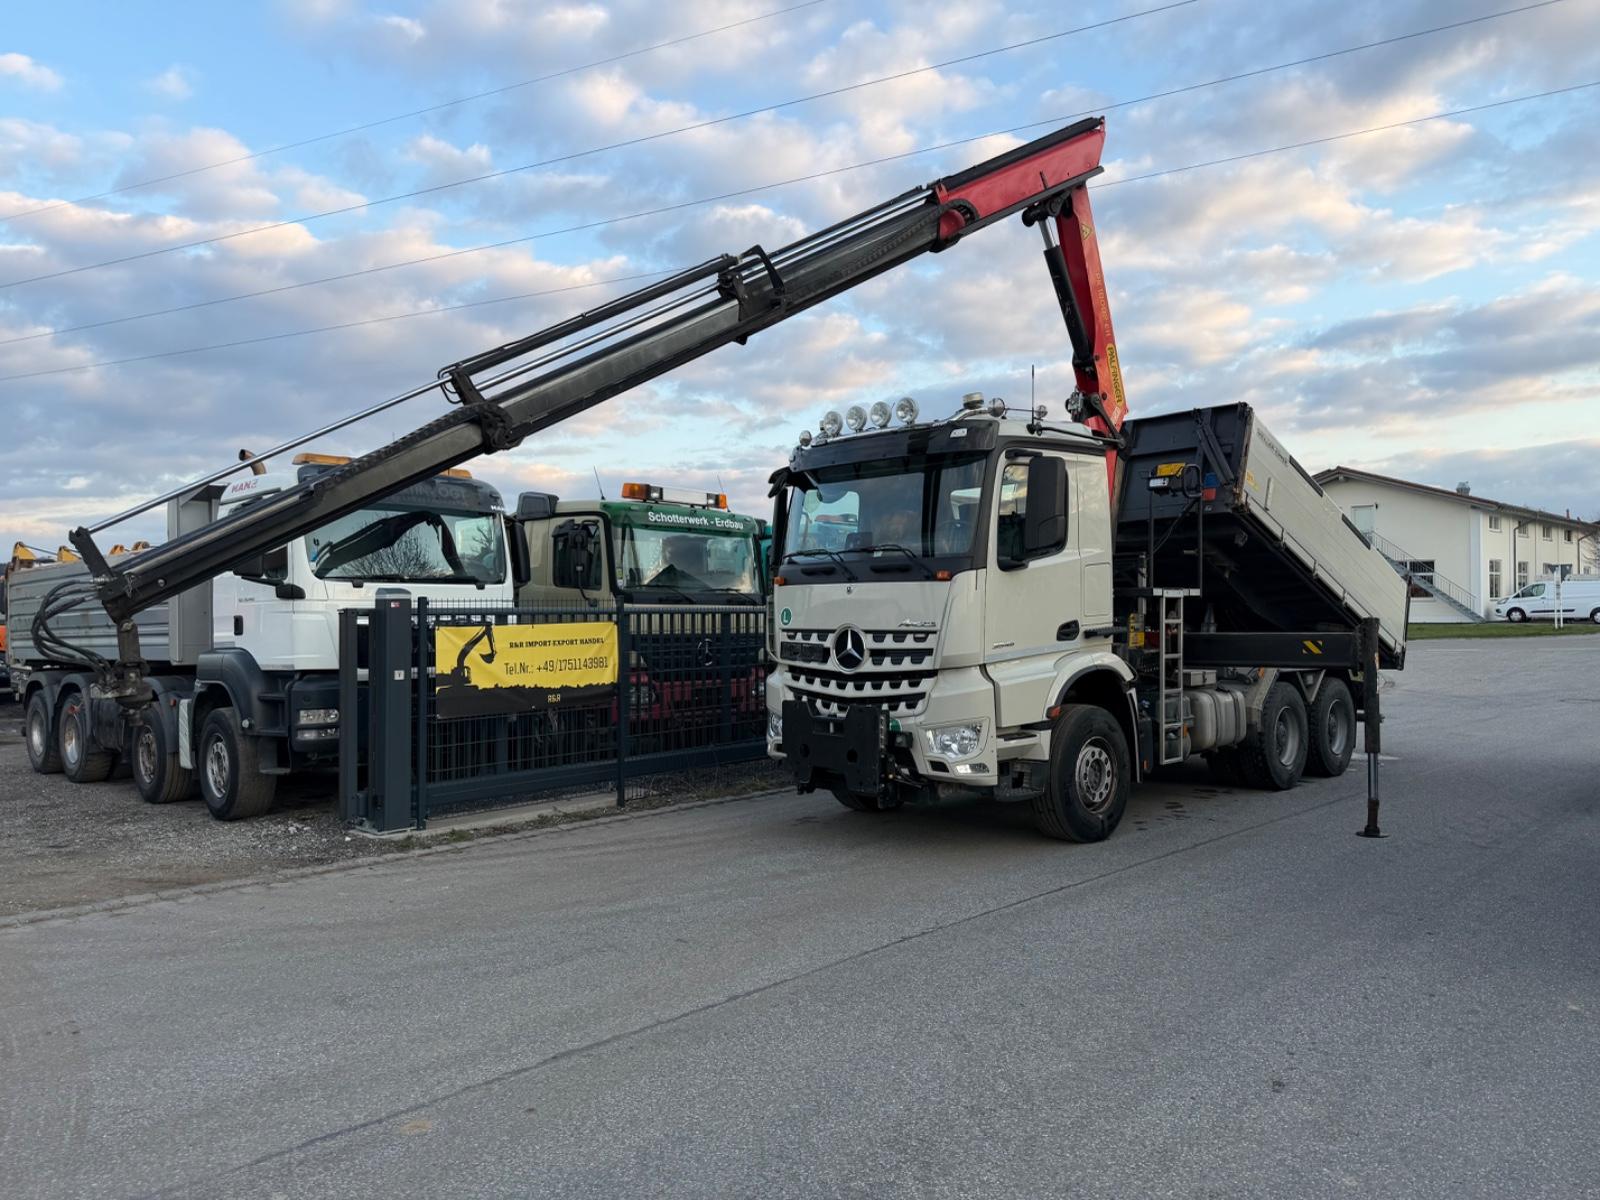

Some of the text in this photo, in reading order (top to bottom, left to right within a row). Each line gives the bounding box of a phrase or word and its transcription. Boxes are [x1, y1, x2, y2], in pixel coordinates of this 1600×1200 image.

[1107, 346, 1122, 404] PALFINGER
[648, 511, 708, 526] Schotterwerk
[715, 517, 744, 530] Erdbau
[509, 641, 524, 649] R&R
[525, 640, 551, 648] IMPORT
[580, 636, 605, 645] HANDEL
